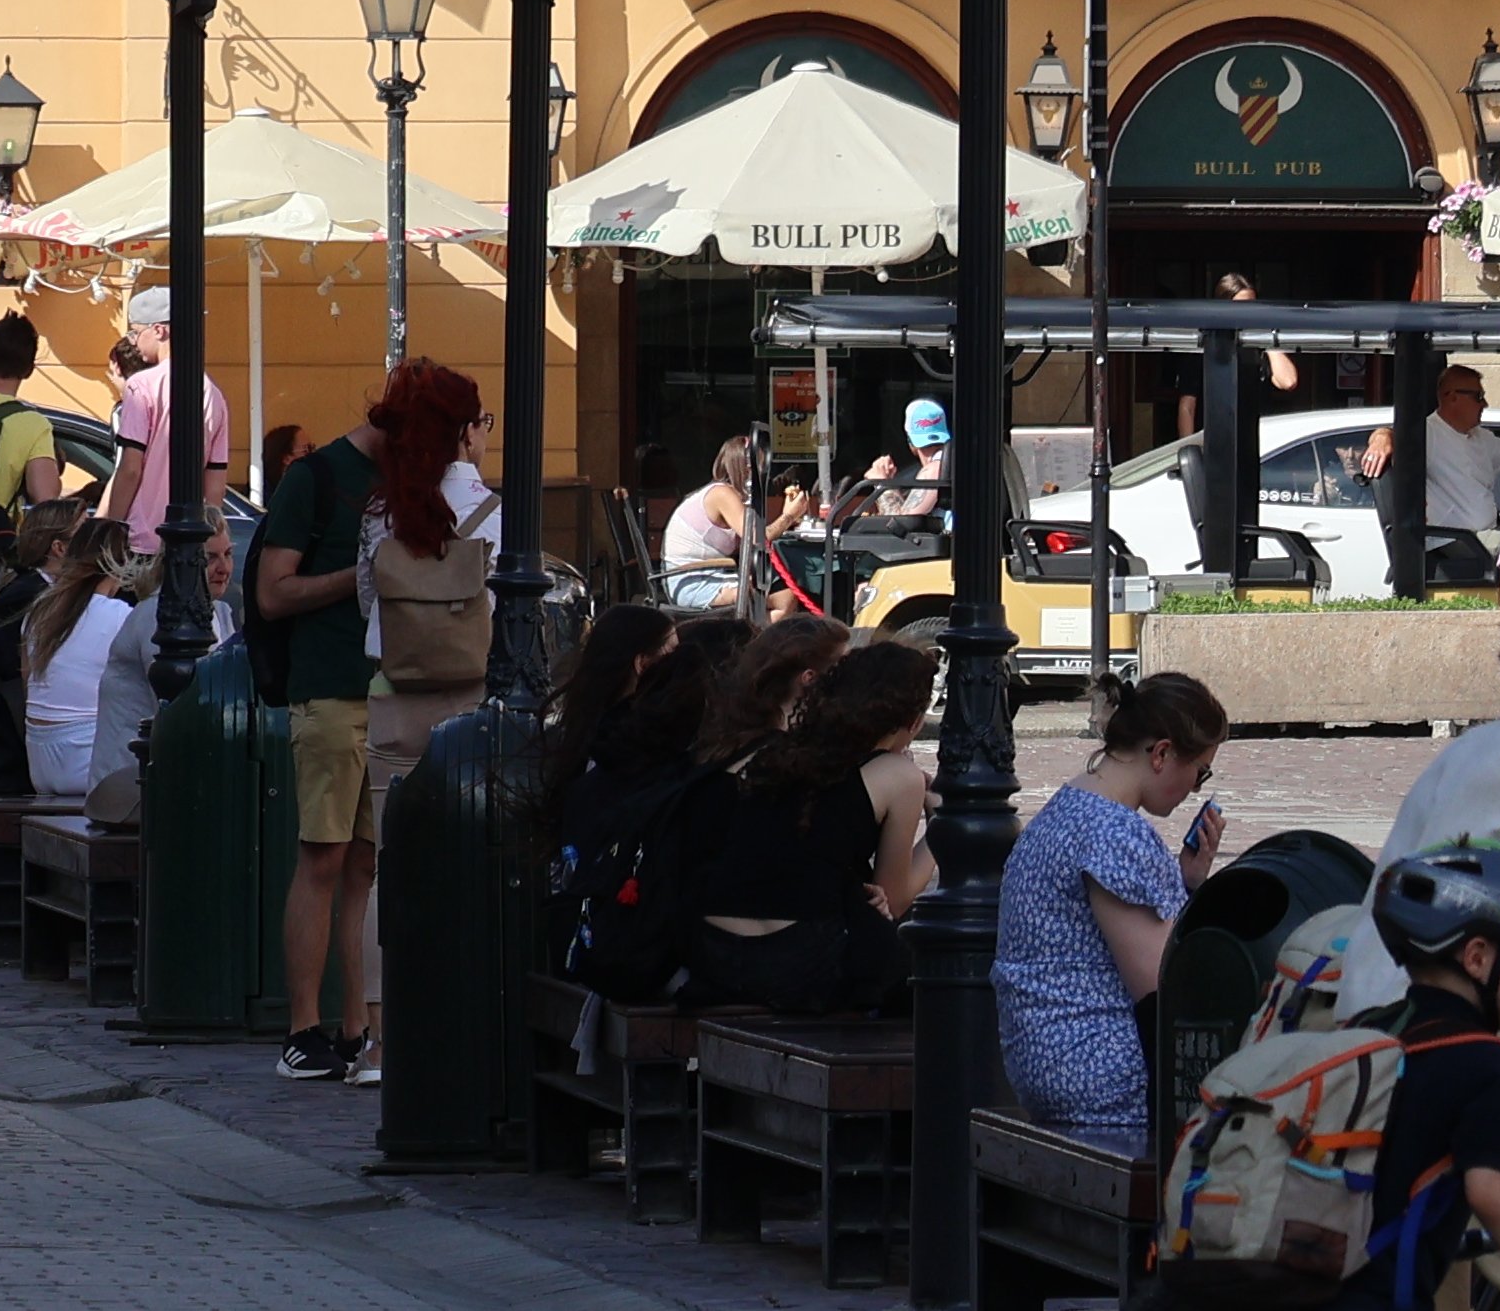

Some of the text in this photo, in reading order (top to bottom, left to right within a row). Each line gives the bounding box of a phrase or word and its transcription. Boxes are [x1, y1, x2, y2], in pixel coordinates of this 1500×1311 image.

[1194, 161, 1323, 175] BULL PUB
[567, 223, 661, 244] Heineken
[750, 224, 902, 249] BULL PUB
